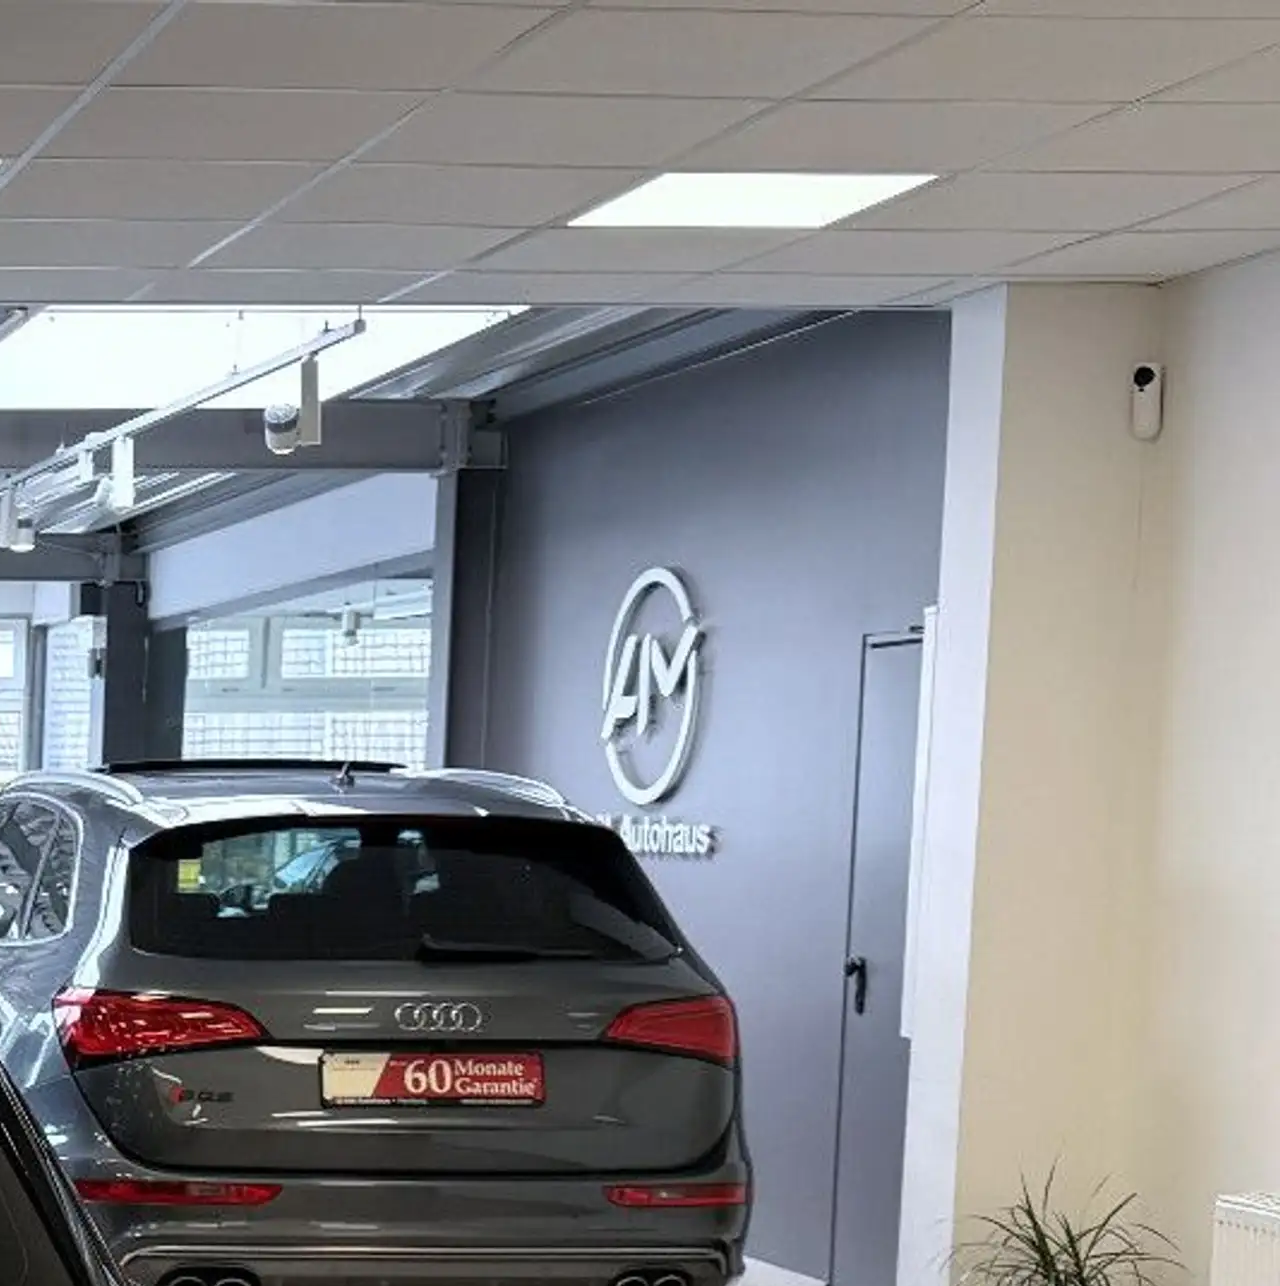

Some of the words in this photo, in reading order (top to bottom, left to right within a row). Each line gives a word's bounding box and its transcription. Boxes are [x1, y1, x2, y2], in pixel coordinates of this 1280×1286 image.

[620, 816, 711, 854] Autohaus
[403, 1058, 452, 1094] 60
[454, 1059, 525, 1077] Monate
